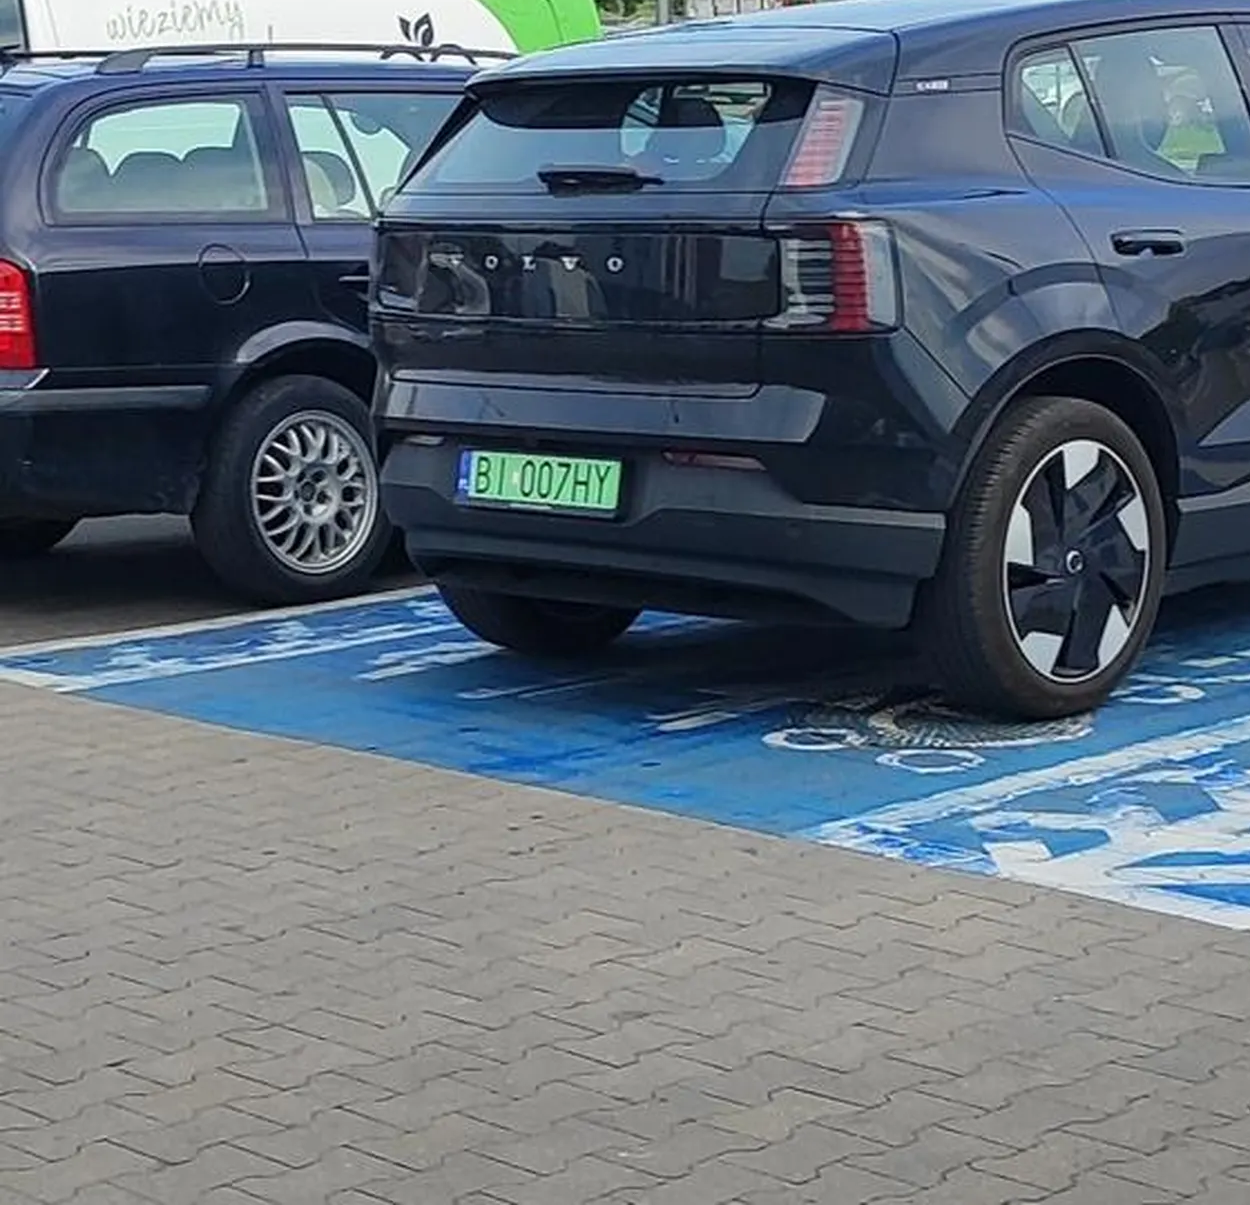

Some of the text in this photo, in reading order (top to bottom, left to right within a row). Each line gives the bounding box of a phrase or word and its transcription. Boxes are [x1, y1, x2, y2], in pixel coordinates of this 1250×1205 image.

[447, 253, 624, 273] VOLVO
[475, 456, 611, 505] BI 007HY
